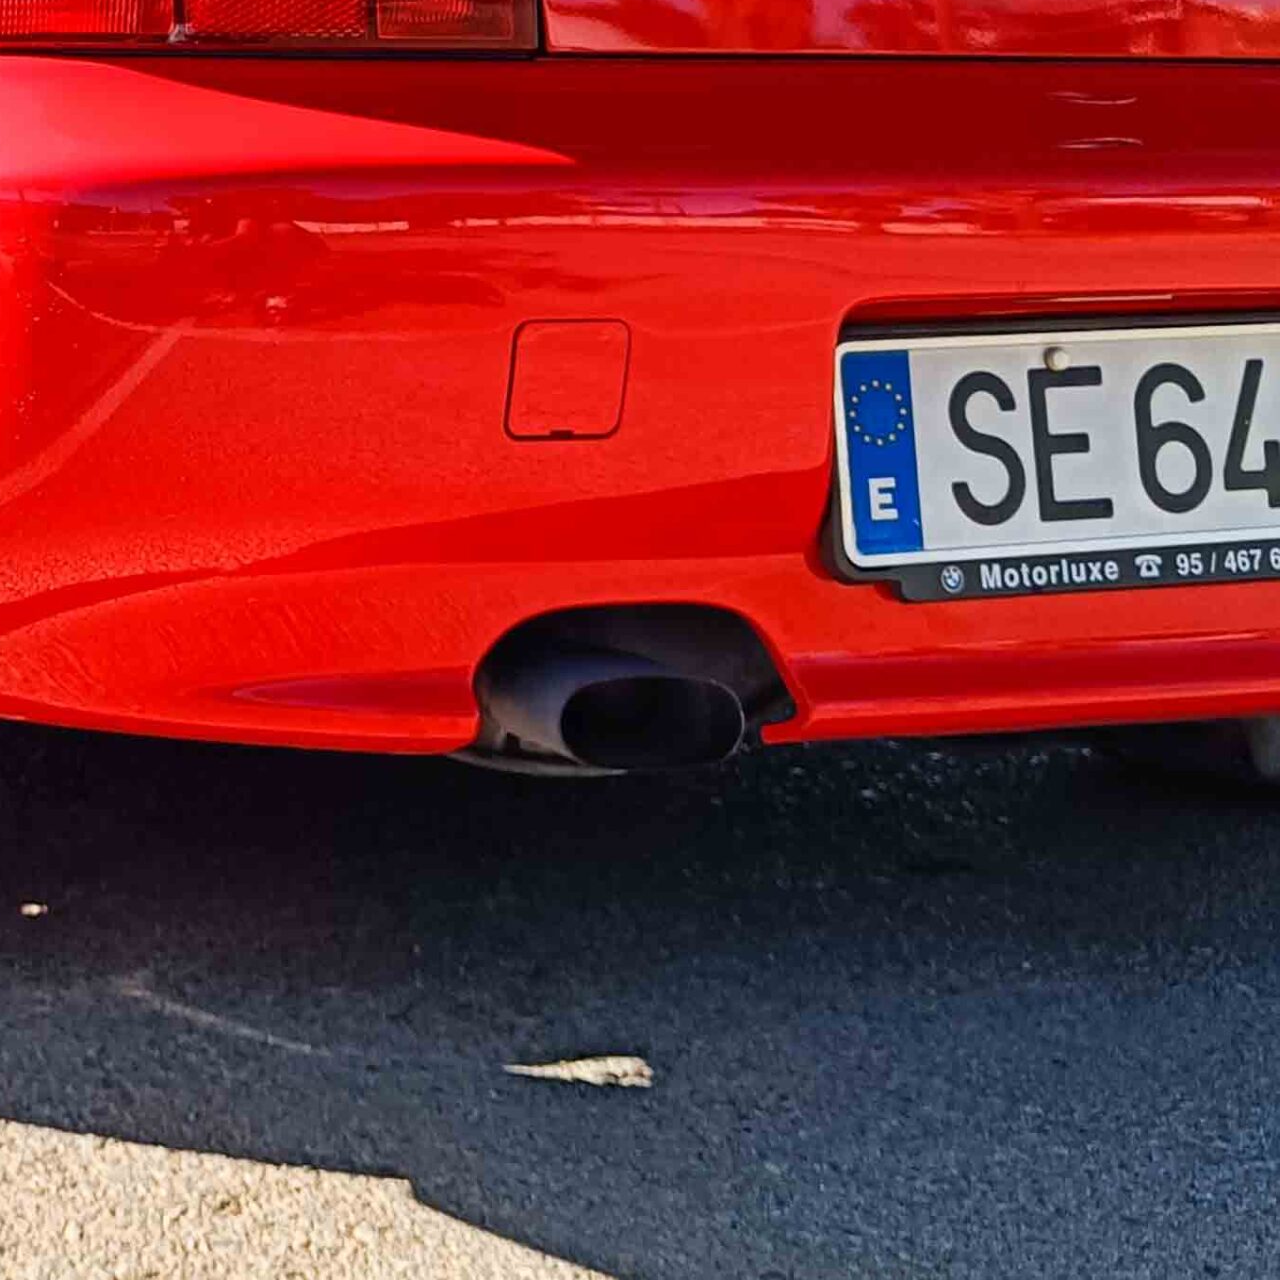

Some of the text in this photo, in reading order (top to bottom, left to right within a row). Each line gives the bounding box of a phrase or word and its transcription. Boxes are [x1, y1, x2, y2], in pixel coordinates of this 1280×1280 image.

[948, 365, 1114, 526] SE
[869, 478, 898, 520] E
[980, 558, 1119, 590] Motorluxe
[1176, 552, 1203, 576] 95
[1224, 548, 1262, 574] 467
